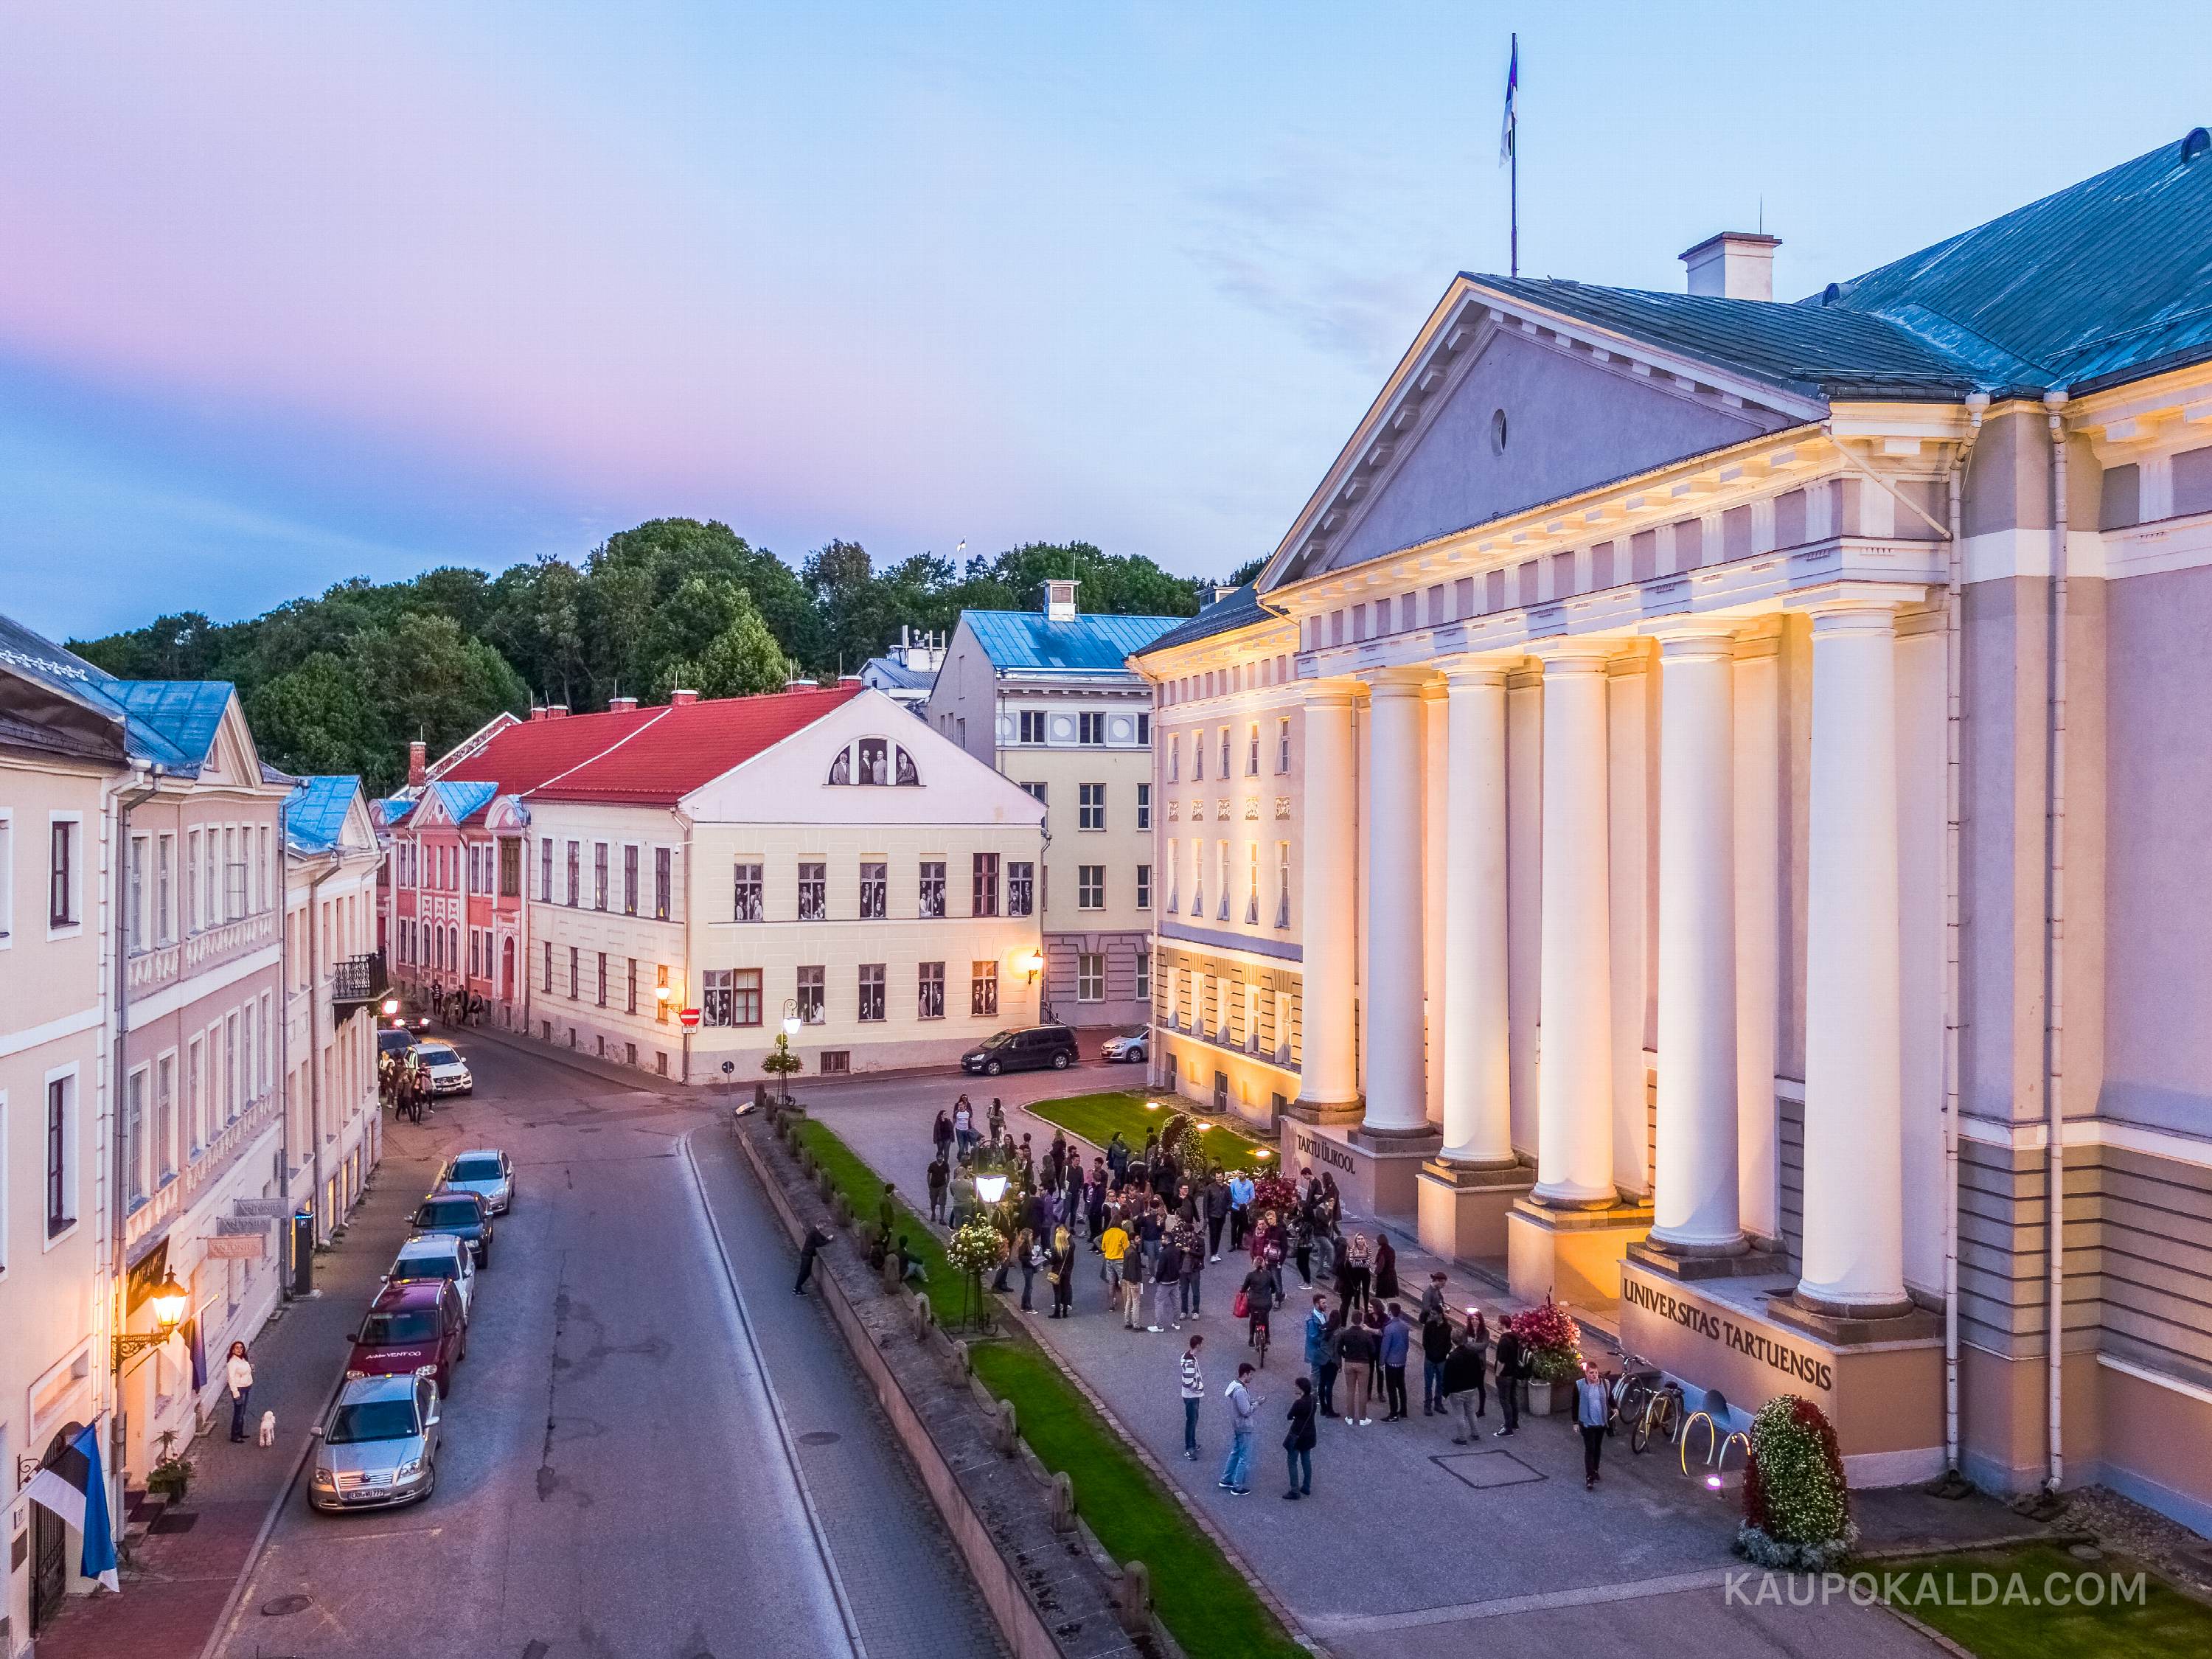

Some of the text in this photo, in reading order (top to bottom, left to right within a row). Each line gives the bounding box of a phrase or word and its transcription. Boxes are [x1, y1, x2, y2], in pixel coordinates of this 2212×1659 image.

[1297, 1134, 1355, 1174] TARTU ÜLIKOOL
[1624, 1278, 1832, 1391] UNIVERSITAS TARTUENSIS
